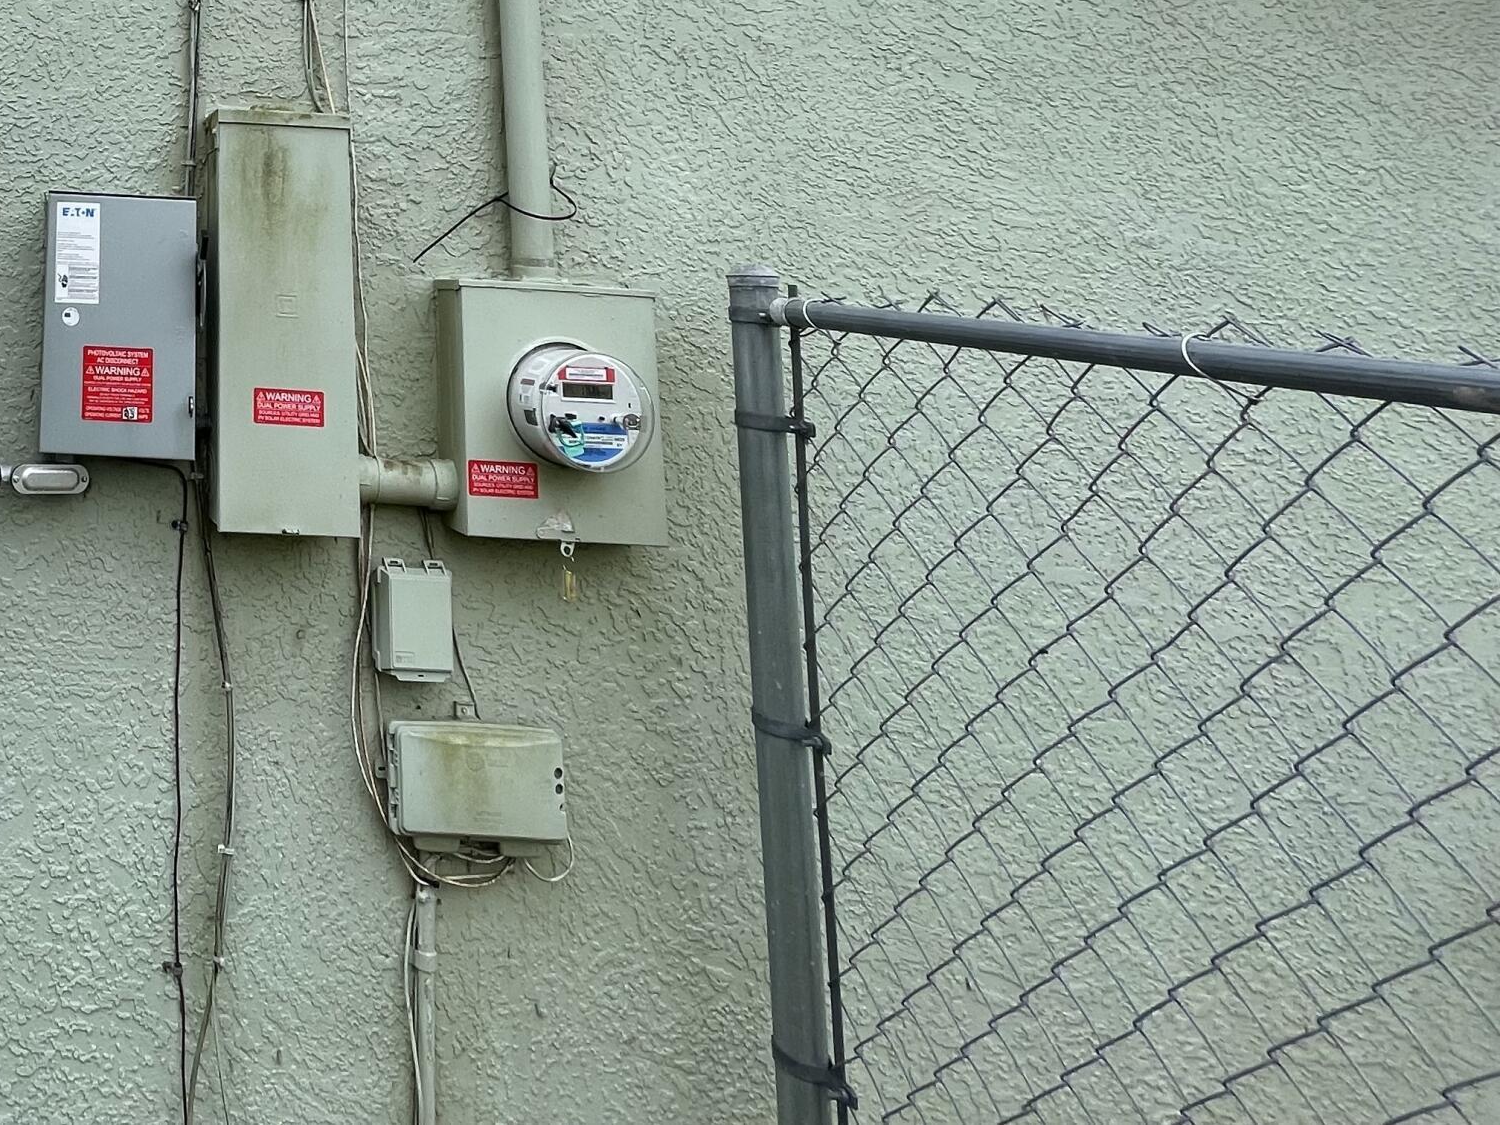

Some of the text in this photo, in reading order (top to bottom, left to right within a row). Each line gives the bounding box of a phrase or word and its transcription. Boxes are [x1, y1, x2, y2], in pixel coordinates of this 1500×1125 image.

[95, 366, 140, 376] WARNING
[266, 392, 312, 403] WARNING
[480, 464, 526, 475] WARNING
